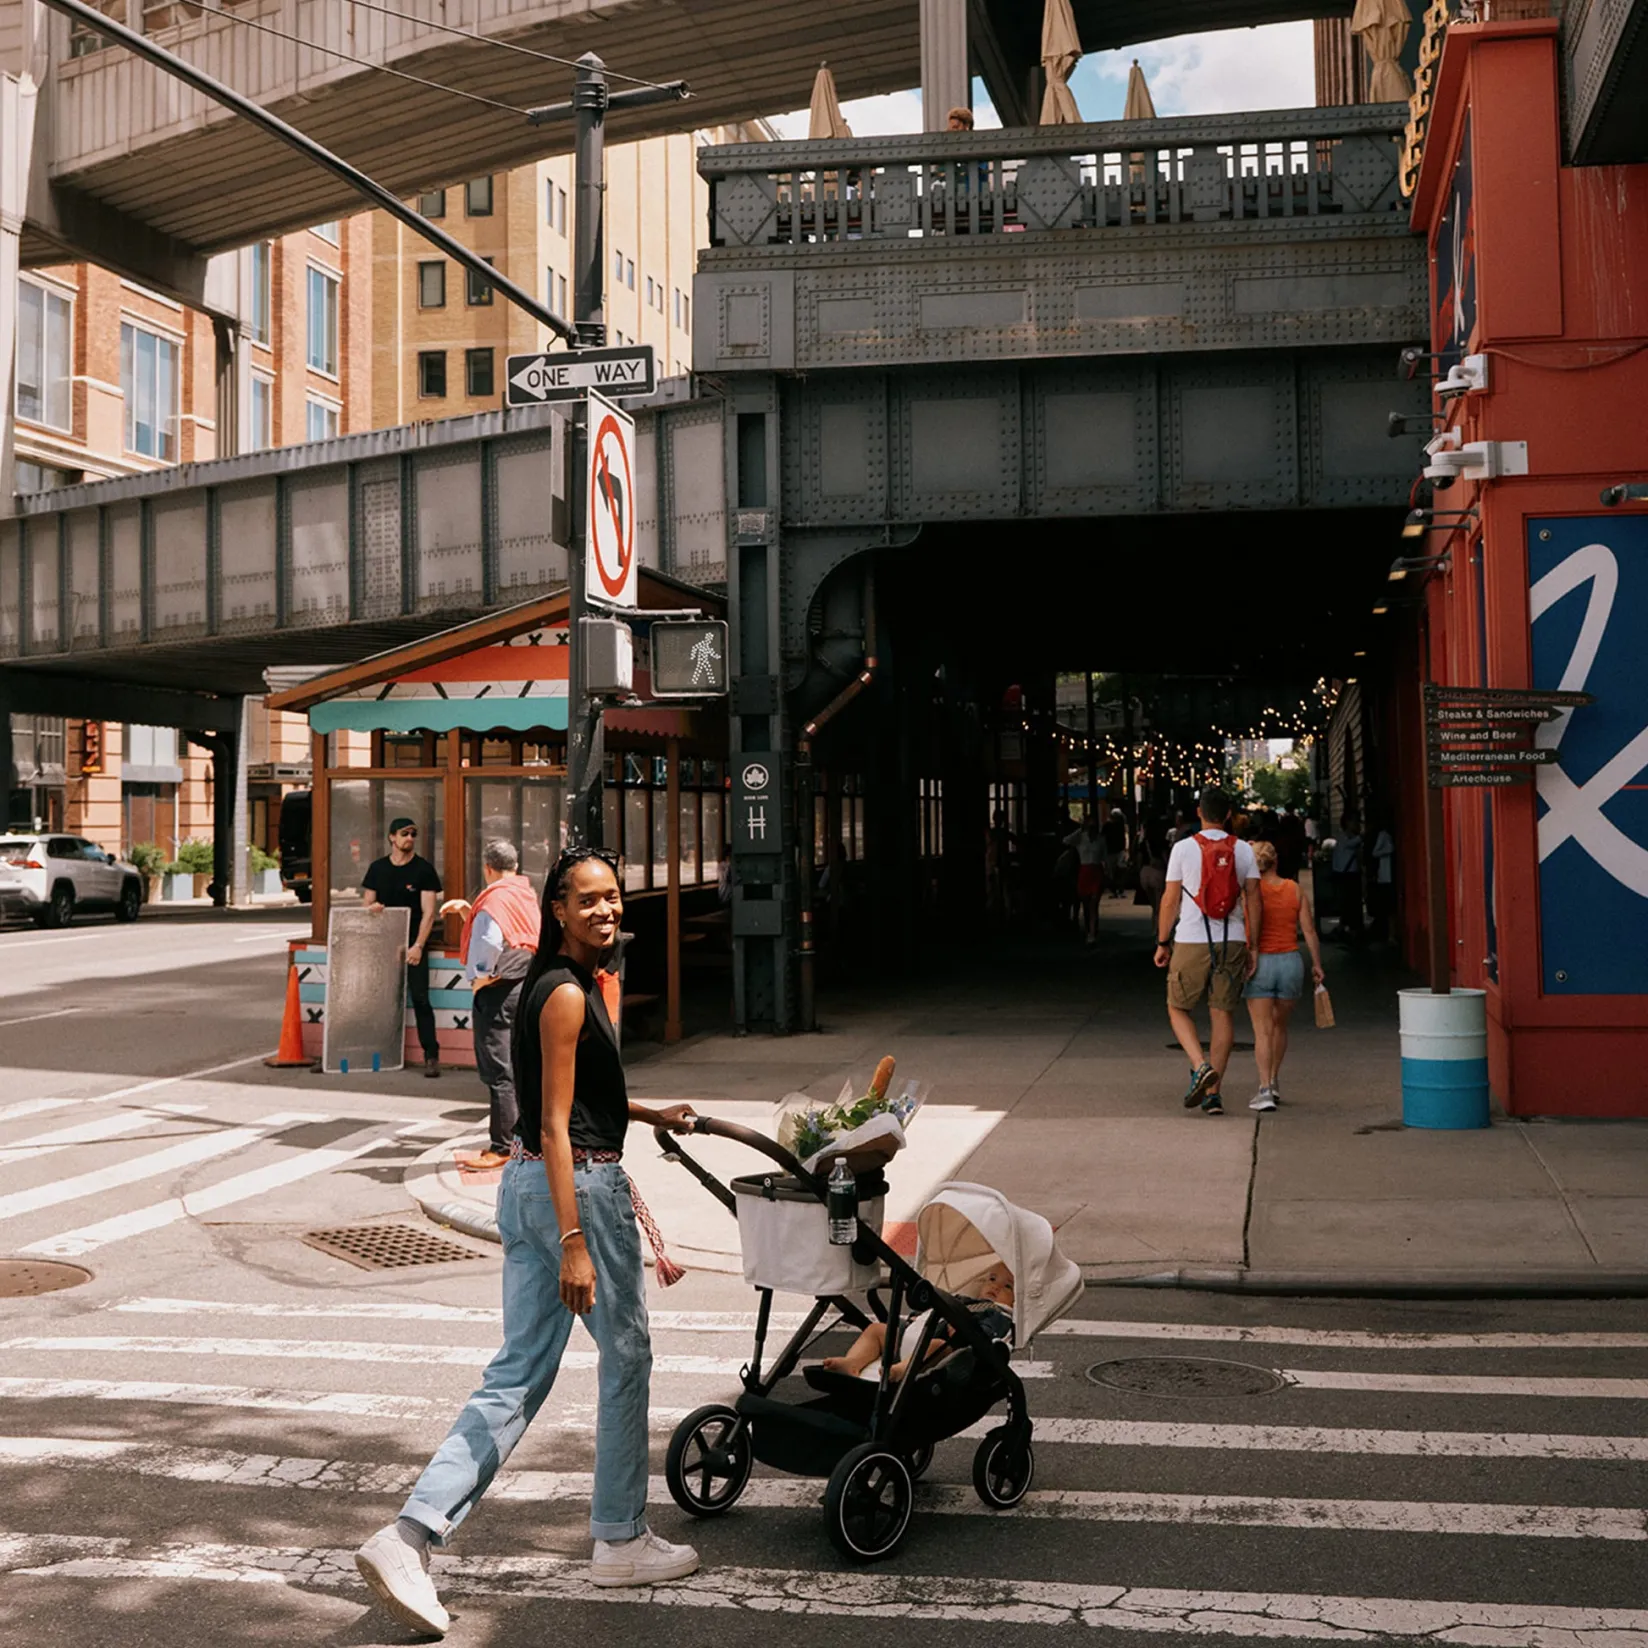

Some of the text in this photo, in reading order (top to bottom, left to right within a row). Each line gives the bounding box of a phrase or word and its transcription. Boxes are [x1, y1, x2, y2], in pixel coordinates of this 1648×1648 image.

[527, 361, 641, 388] ONE WAY
[1437, 709, 1549, 719] Steaks & Sandwiches
[1440, 730, 1517, 740] Wine and Beer
[1440, 751, 1546, 761] Mediterranean Food
[1452, 774, 1512, 783] Artechouse
